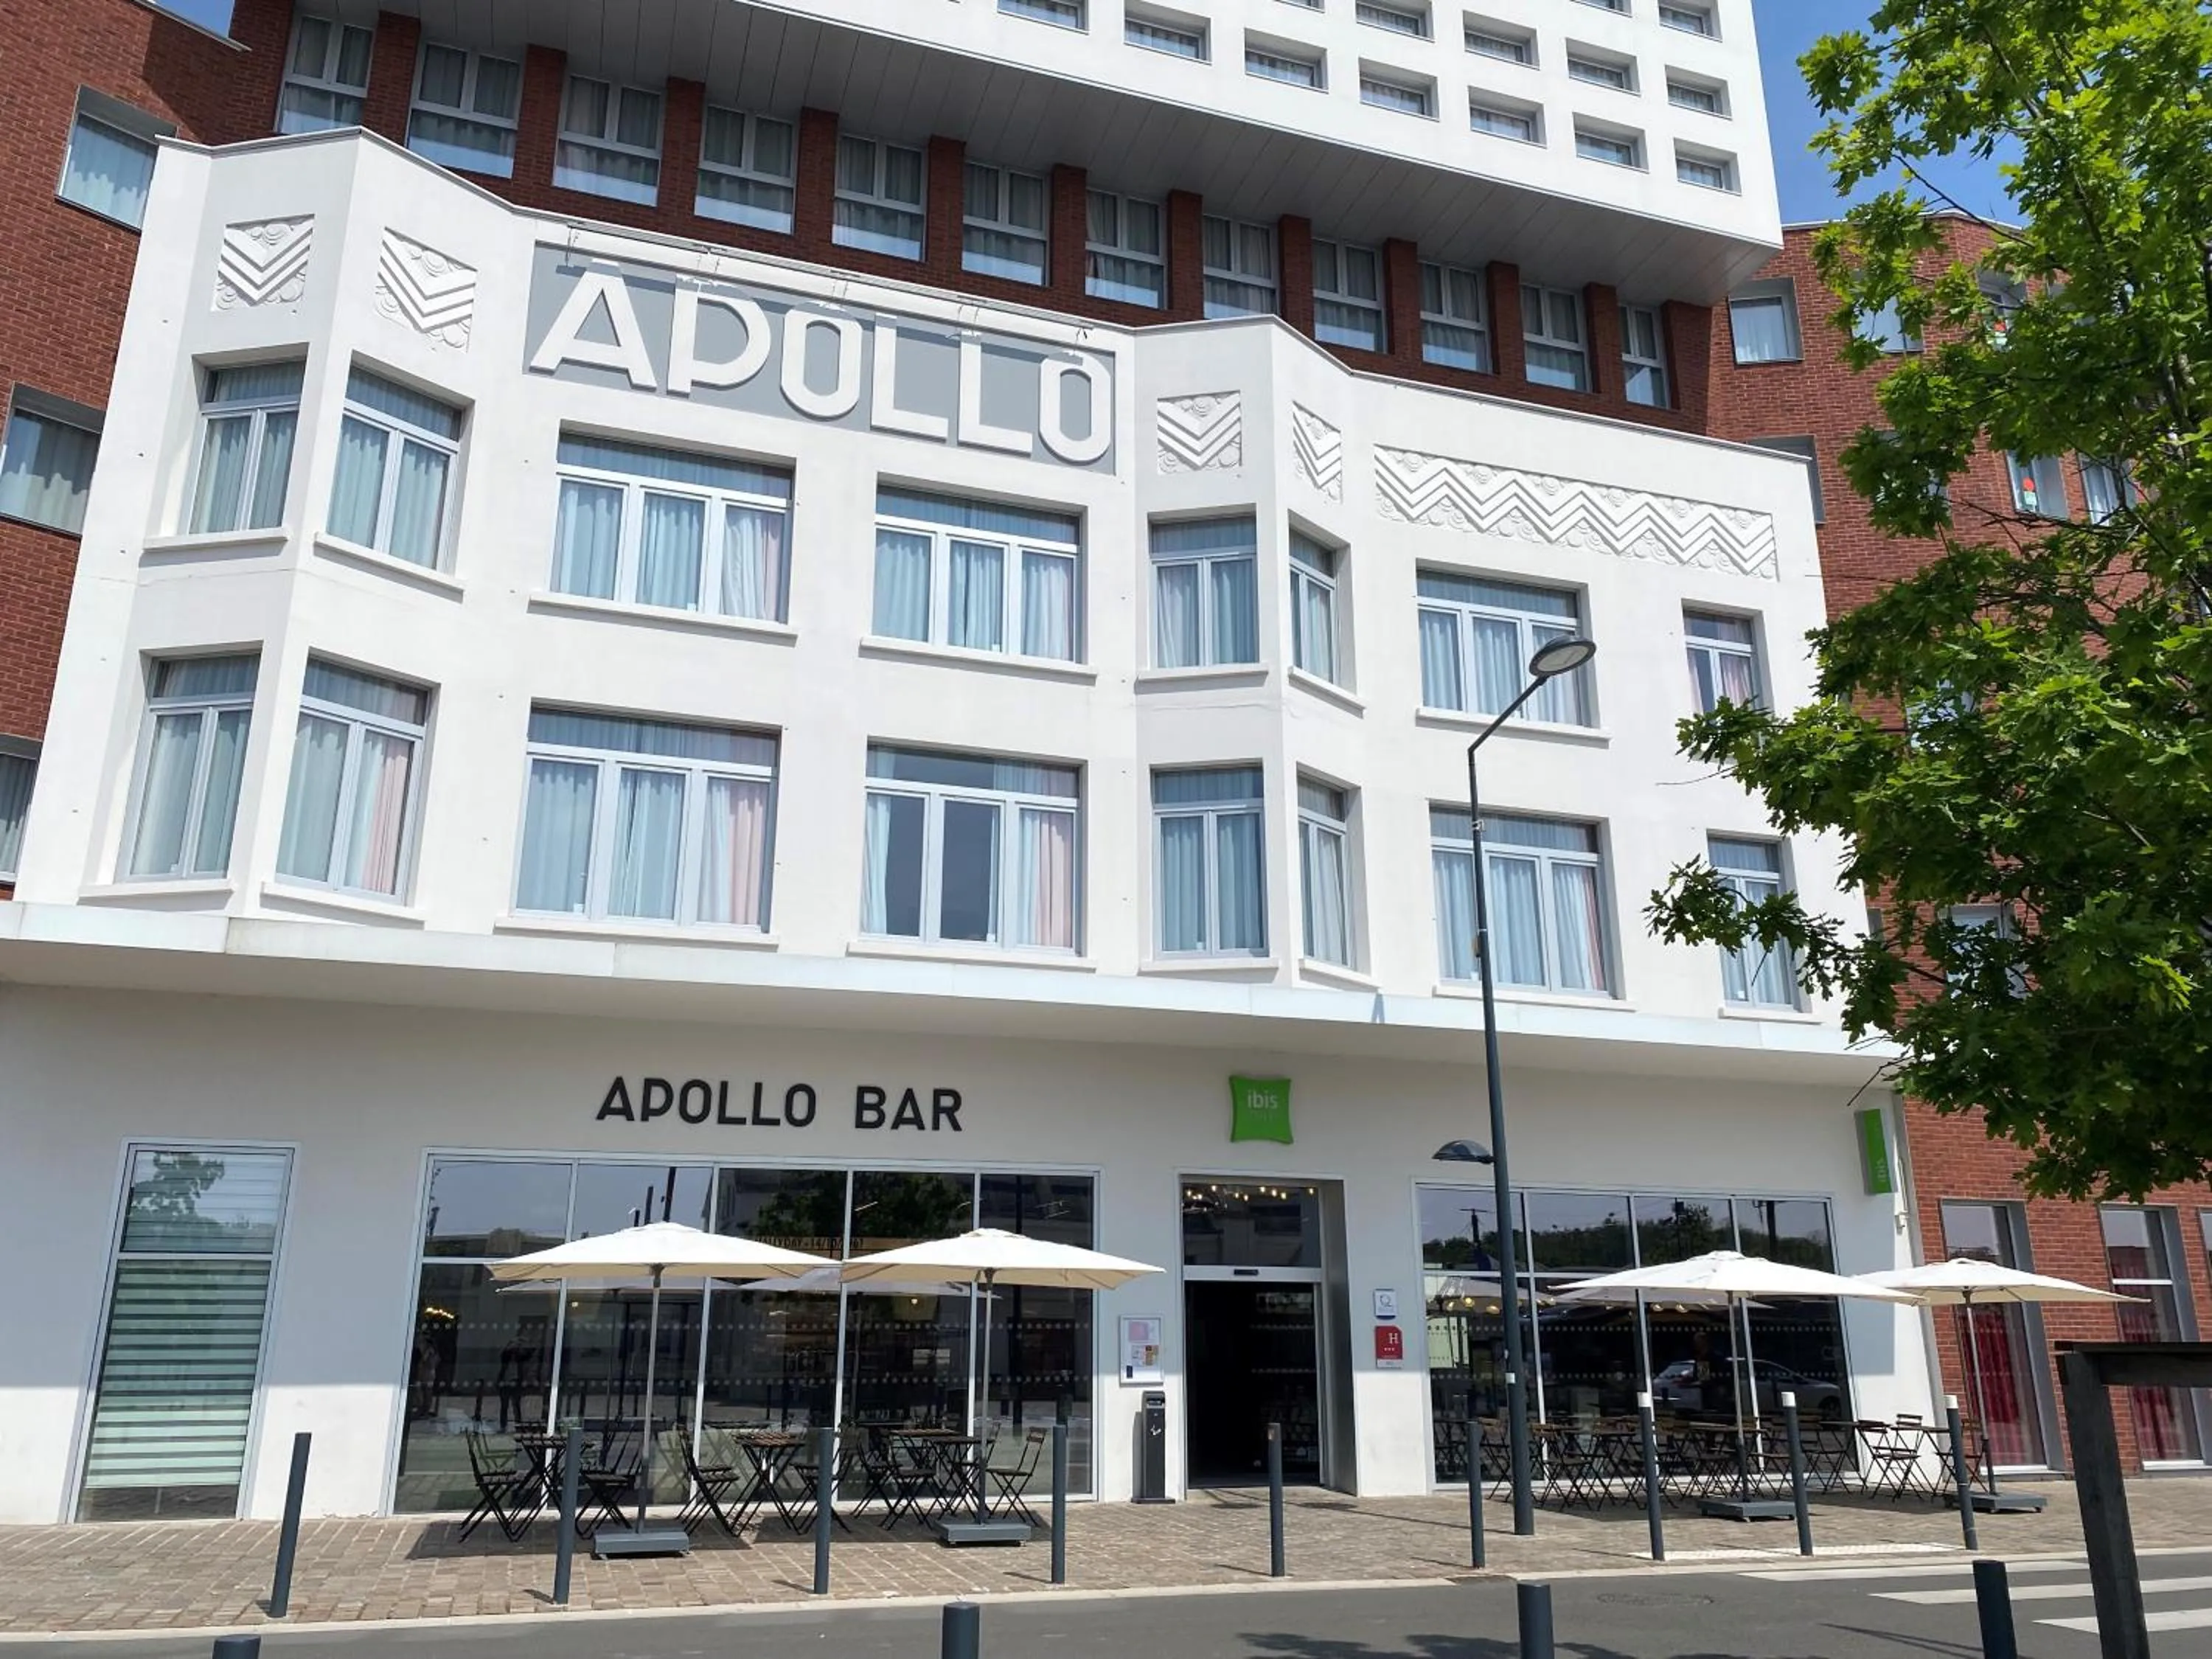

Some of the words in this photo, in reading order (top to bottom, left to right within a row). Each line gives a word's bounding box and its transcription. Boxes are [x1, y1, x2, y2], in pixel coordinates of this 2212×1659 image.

[529, 258, 1111, 463] APOLLO
[596, 1076, 816, 1127] APOLLO
[854, 1085, 962, 1132] BAR
[1248, 1090, 1278, 1109] ibis
[1388, 1332, 1399, 1344] H
